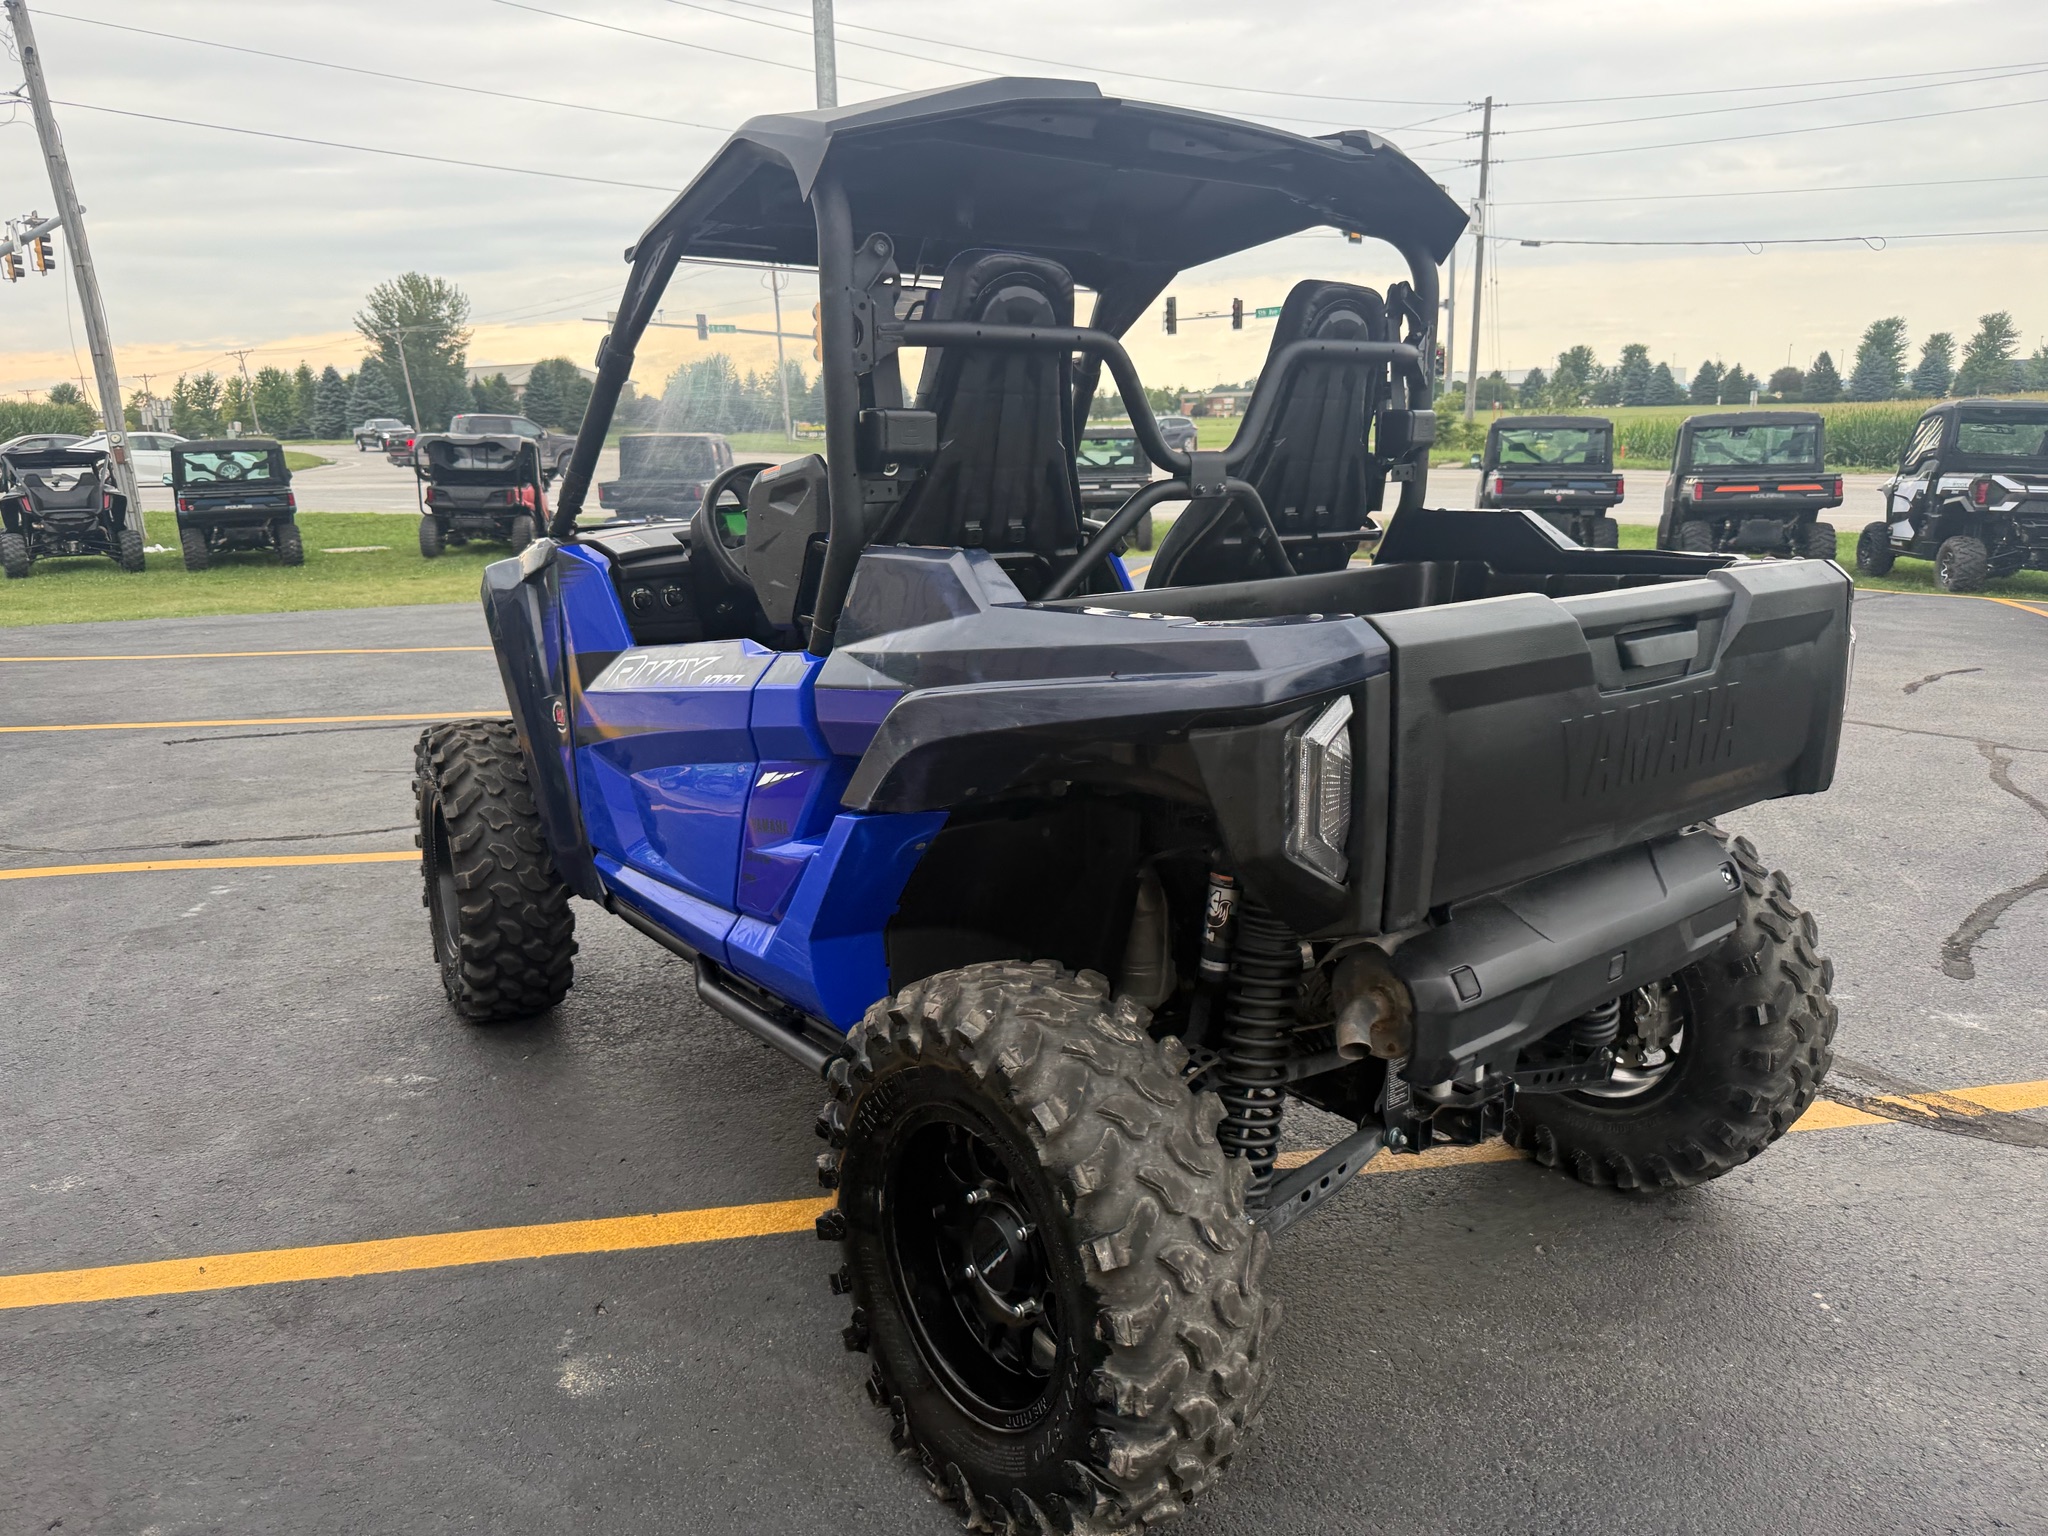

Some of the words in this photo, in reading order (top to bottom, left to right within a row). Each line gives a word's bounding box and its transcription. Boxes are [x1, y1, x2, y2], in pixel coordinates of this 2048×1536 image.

[701, 674, 746, 686] 1000
[1560, 681, 1743, 802] YAMAHA
[750, 818, 790, 835] YAMAHA
